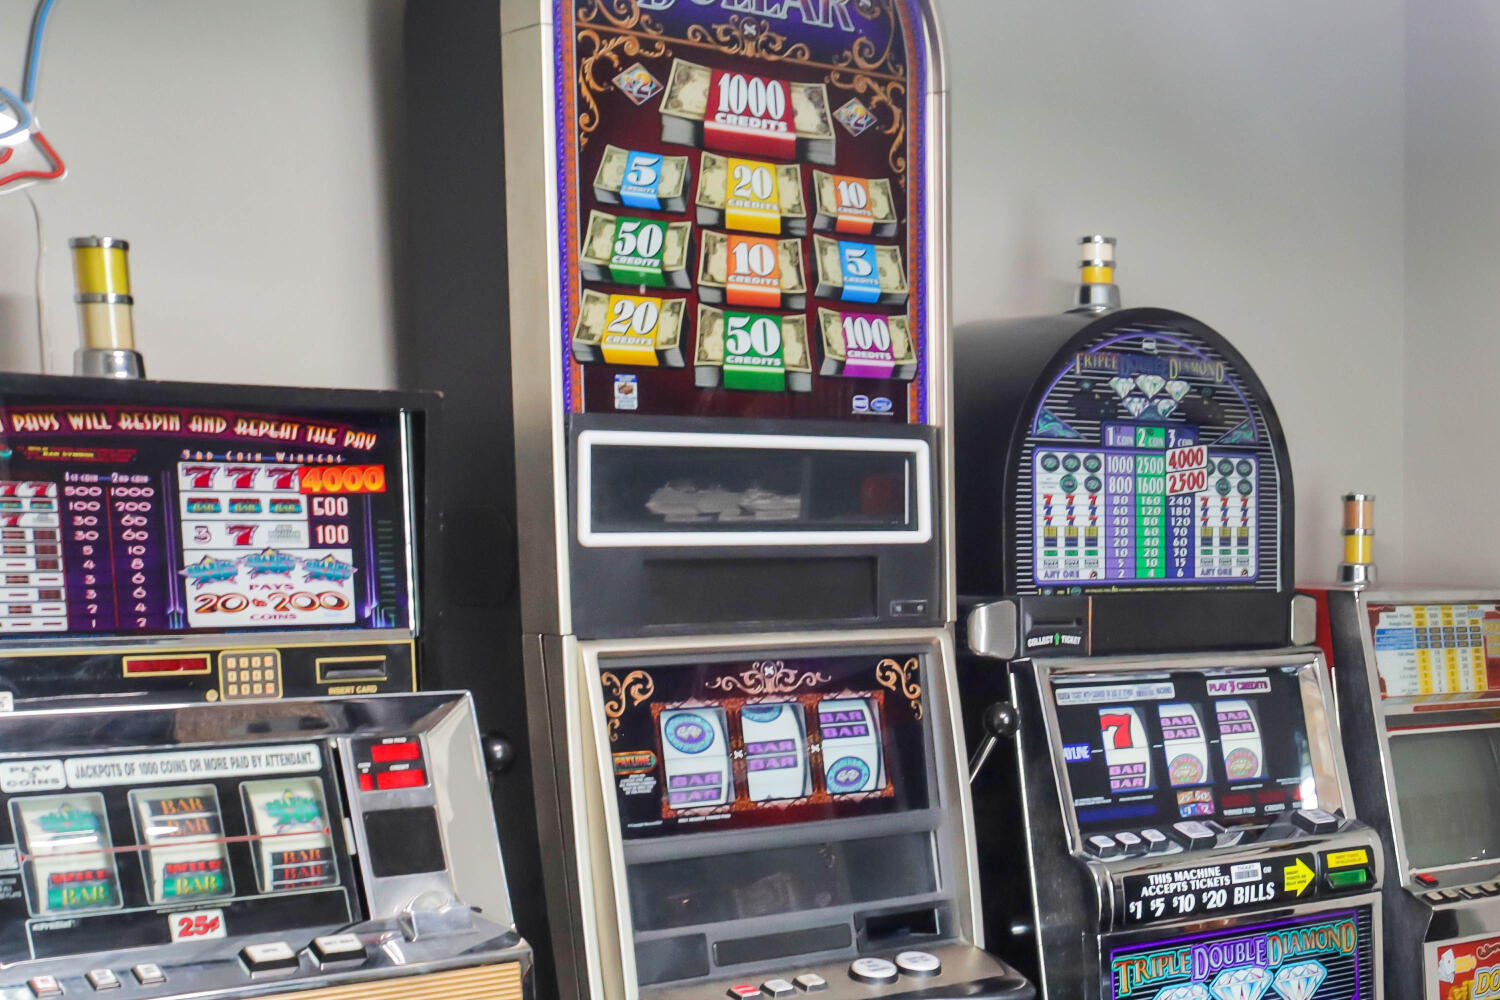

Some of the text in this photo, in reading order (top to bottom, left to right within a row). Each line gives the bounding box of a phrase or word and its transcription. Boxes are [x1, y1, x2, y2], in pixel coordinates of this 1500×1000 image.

[717, 73, 785, 120] 1000
[714, 112, 788, 133] CREDITS
[626, 157, 660, 186] 5
[732, 165, 774, 200] 20
[837, 180, 867, 209] 10
[614, 221, 664, 258] 50
[611, 255, 660, 267] CREDITS
[731, 243, 775, 276] 10
[844, 249, 873, 277] 5
[728, 274, 779, 286] CREDITS
[607, 300, 659, 335] 20
[726, 317, 782, 356] 50
[842, 317, 890, 351] 100
[725, 354, 785, 367] CREDITS
[847, 349, 893, 361] CREDITS
[1074, 352, 1120, 375] TRIPLE
[1169, 358, 1225, 383] DIAMOND
[12, 412, 377, 451] PAYS WILL RESPIN AND REPEAT THE PAY
[1107, 455, 1133, 475] 1000
[1137, 457, 1164, 475] 2500
[301, 465, 385, 493] 4000
[1108, 476, 1133, 493] 800
[1137, 476, 1165, 494] 1600
[64, 487, 154, 497] 500 1000
[69, 501, 100, 511] 100
[193, 525, 211, 544] 3
[316, 525, 349, 545] 100
[194, 591, 350, 614] 20 200
[1027, 635, 1082, 648] COLLECT TICKET
[355, 685, 378, 694] CARD
[822, 724, 869, 738] BAR
[1101, 713, 1133, 749] 7
[1164, 728, 1199, 739] BAR
[746, 740, 795, 755] BAR
[75, 752, 315, 778] JACKPOTS OF 1000 COINS OR MORE PAID BY ATTENDANT.
[1110, 764, 1145, 776] BAR
[6, 777, 60, 786] COINS
[161, 797, 205, 814] BAR
[1141, 881, 1188, 897] ACCEPTS
[1190, 876, 1231, 891] TICKETS
[1147, 866, 1221, 886] THIS MACHINE
[61, 883, 106, 906] BAR
[1129, 882, 1275, 919] $1 $5 $10 $20 BILLS
[178, 915, 220, 937] 25¢
[1113, 920, 1357, 995] TRIPLE DOUBLE DIAMOND
